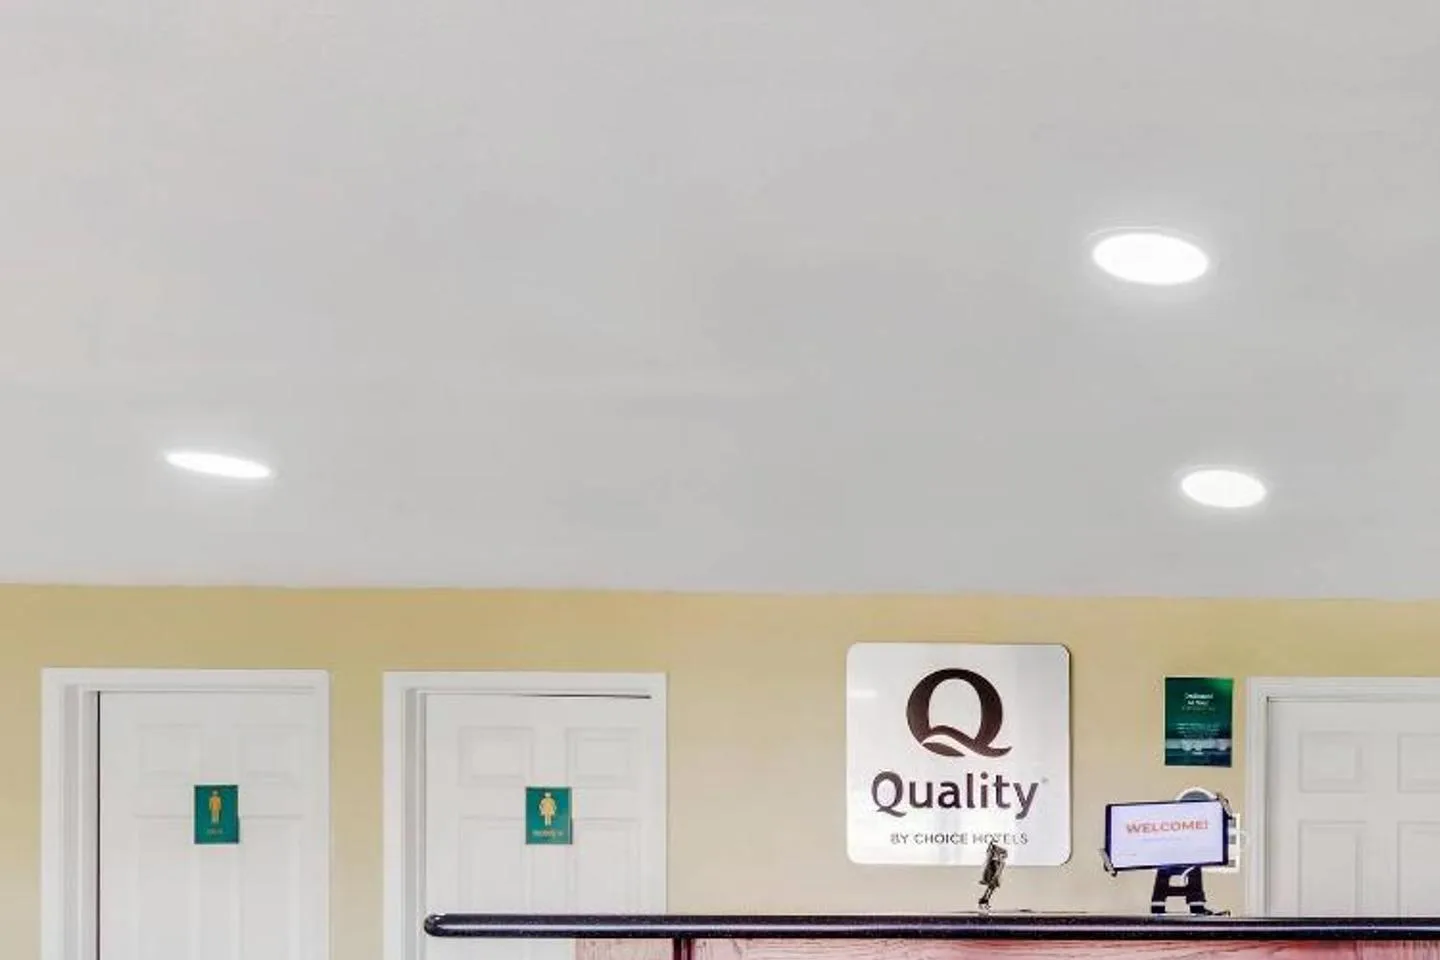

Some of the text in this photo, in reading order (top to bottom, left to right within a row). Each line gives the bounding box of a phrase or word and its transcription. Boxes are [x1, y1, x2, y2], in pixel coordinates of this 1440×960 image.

[906, 668, 1012, 758] Q
[871, 771, 1039, 820] Quality
[890, 833, 1028, 844] BY CHOICE HOTELS
[1126, 818, 1208, 834] WELCOME!
